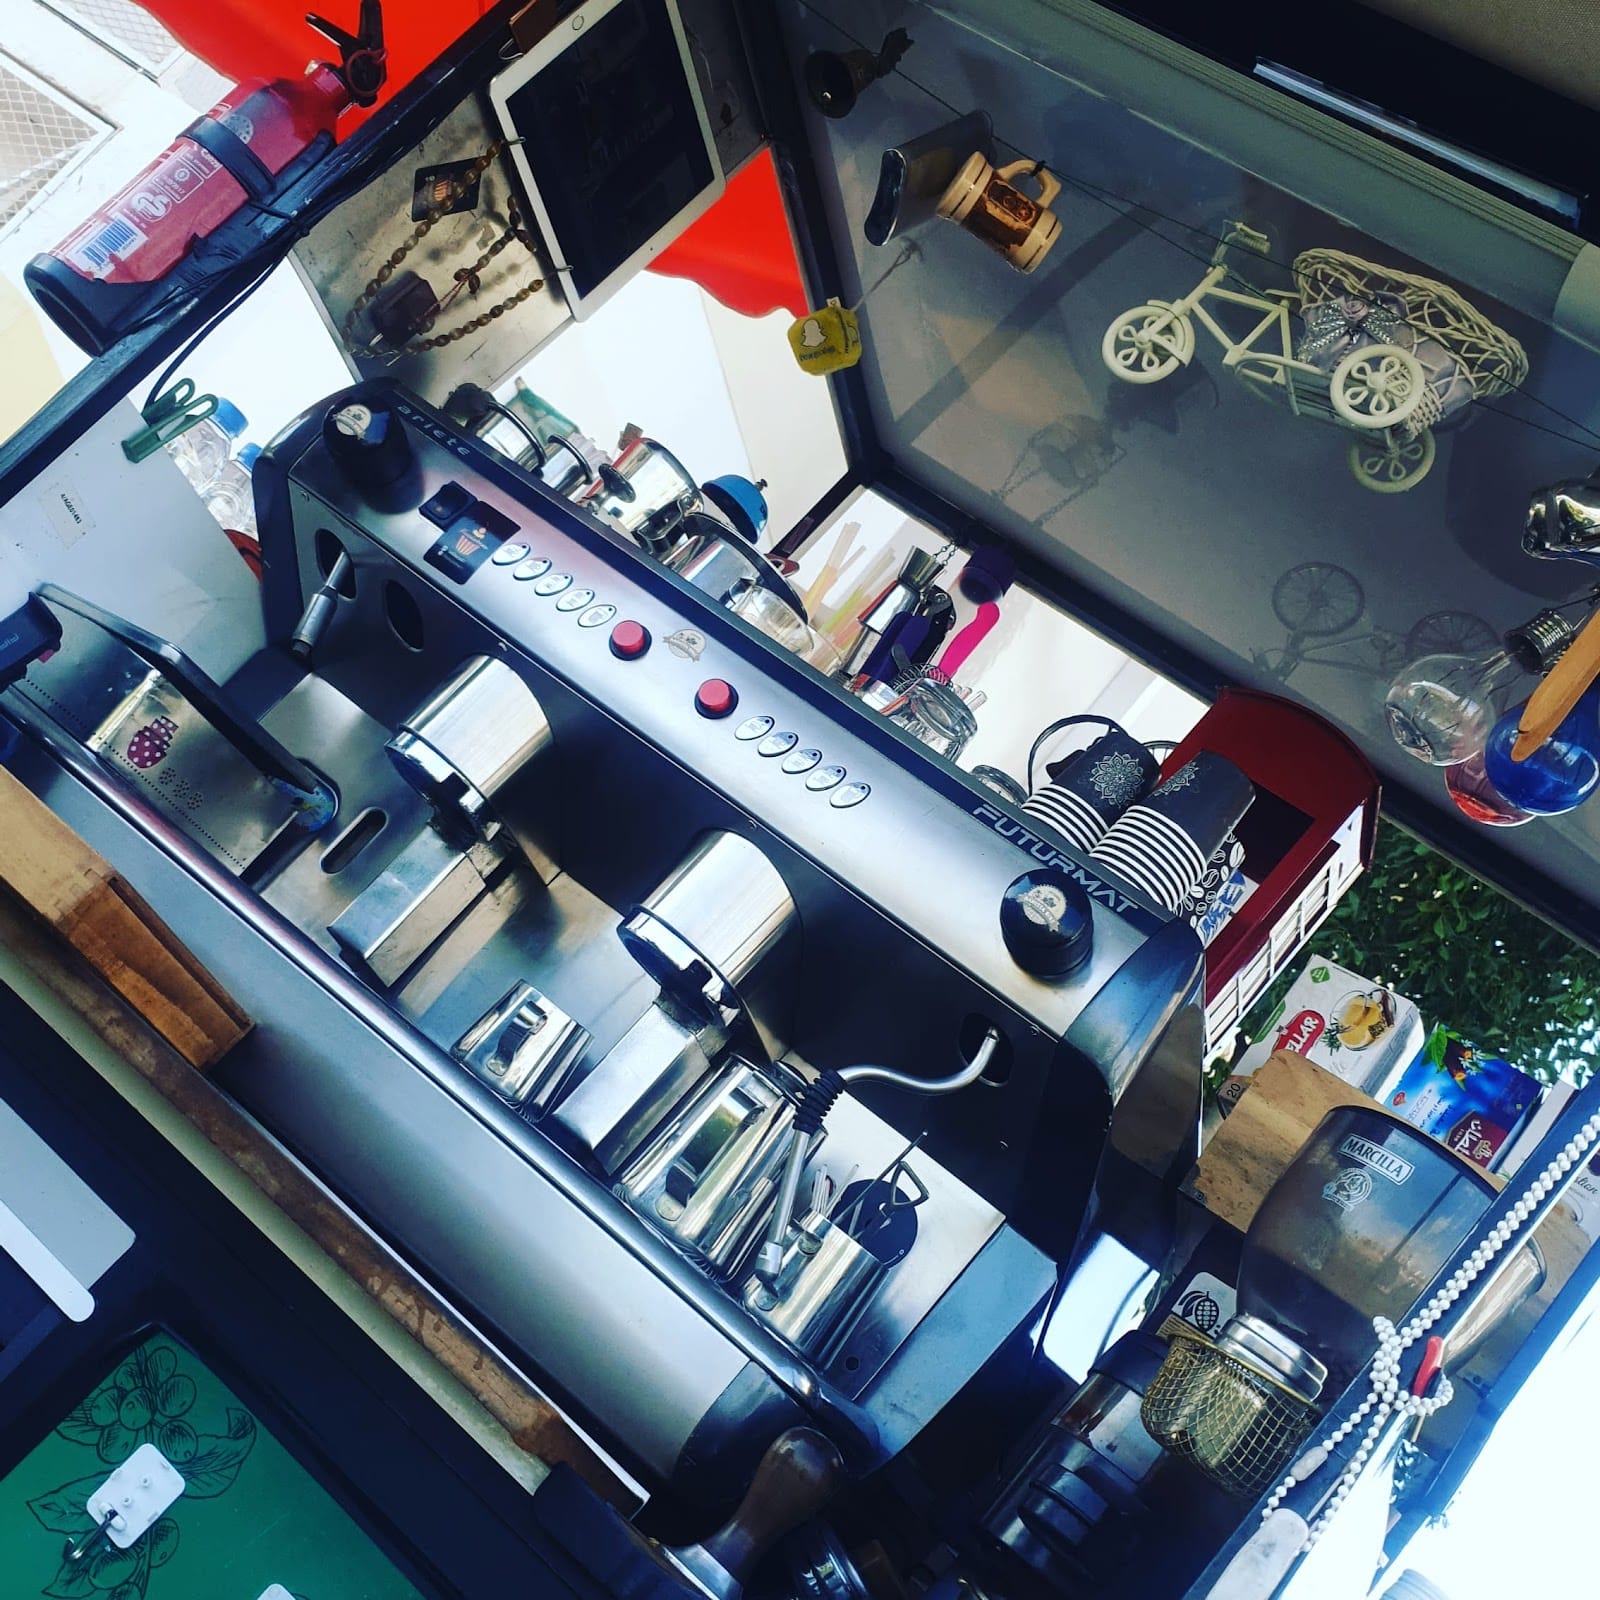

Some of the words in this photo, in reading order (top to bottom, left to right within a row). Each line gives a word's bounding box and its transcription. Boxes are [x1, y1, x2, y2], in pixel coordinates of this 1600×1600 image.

[973, 803, 1138, 913] FUTURMAT
[1285, 1016, 1320, 1053] ELLAR
[1226, 1083, 1241, 1098] 20
[1343, 1138, 1404, 1178] MARCILLA
